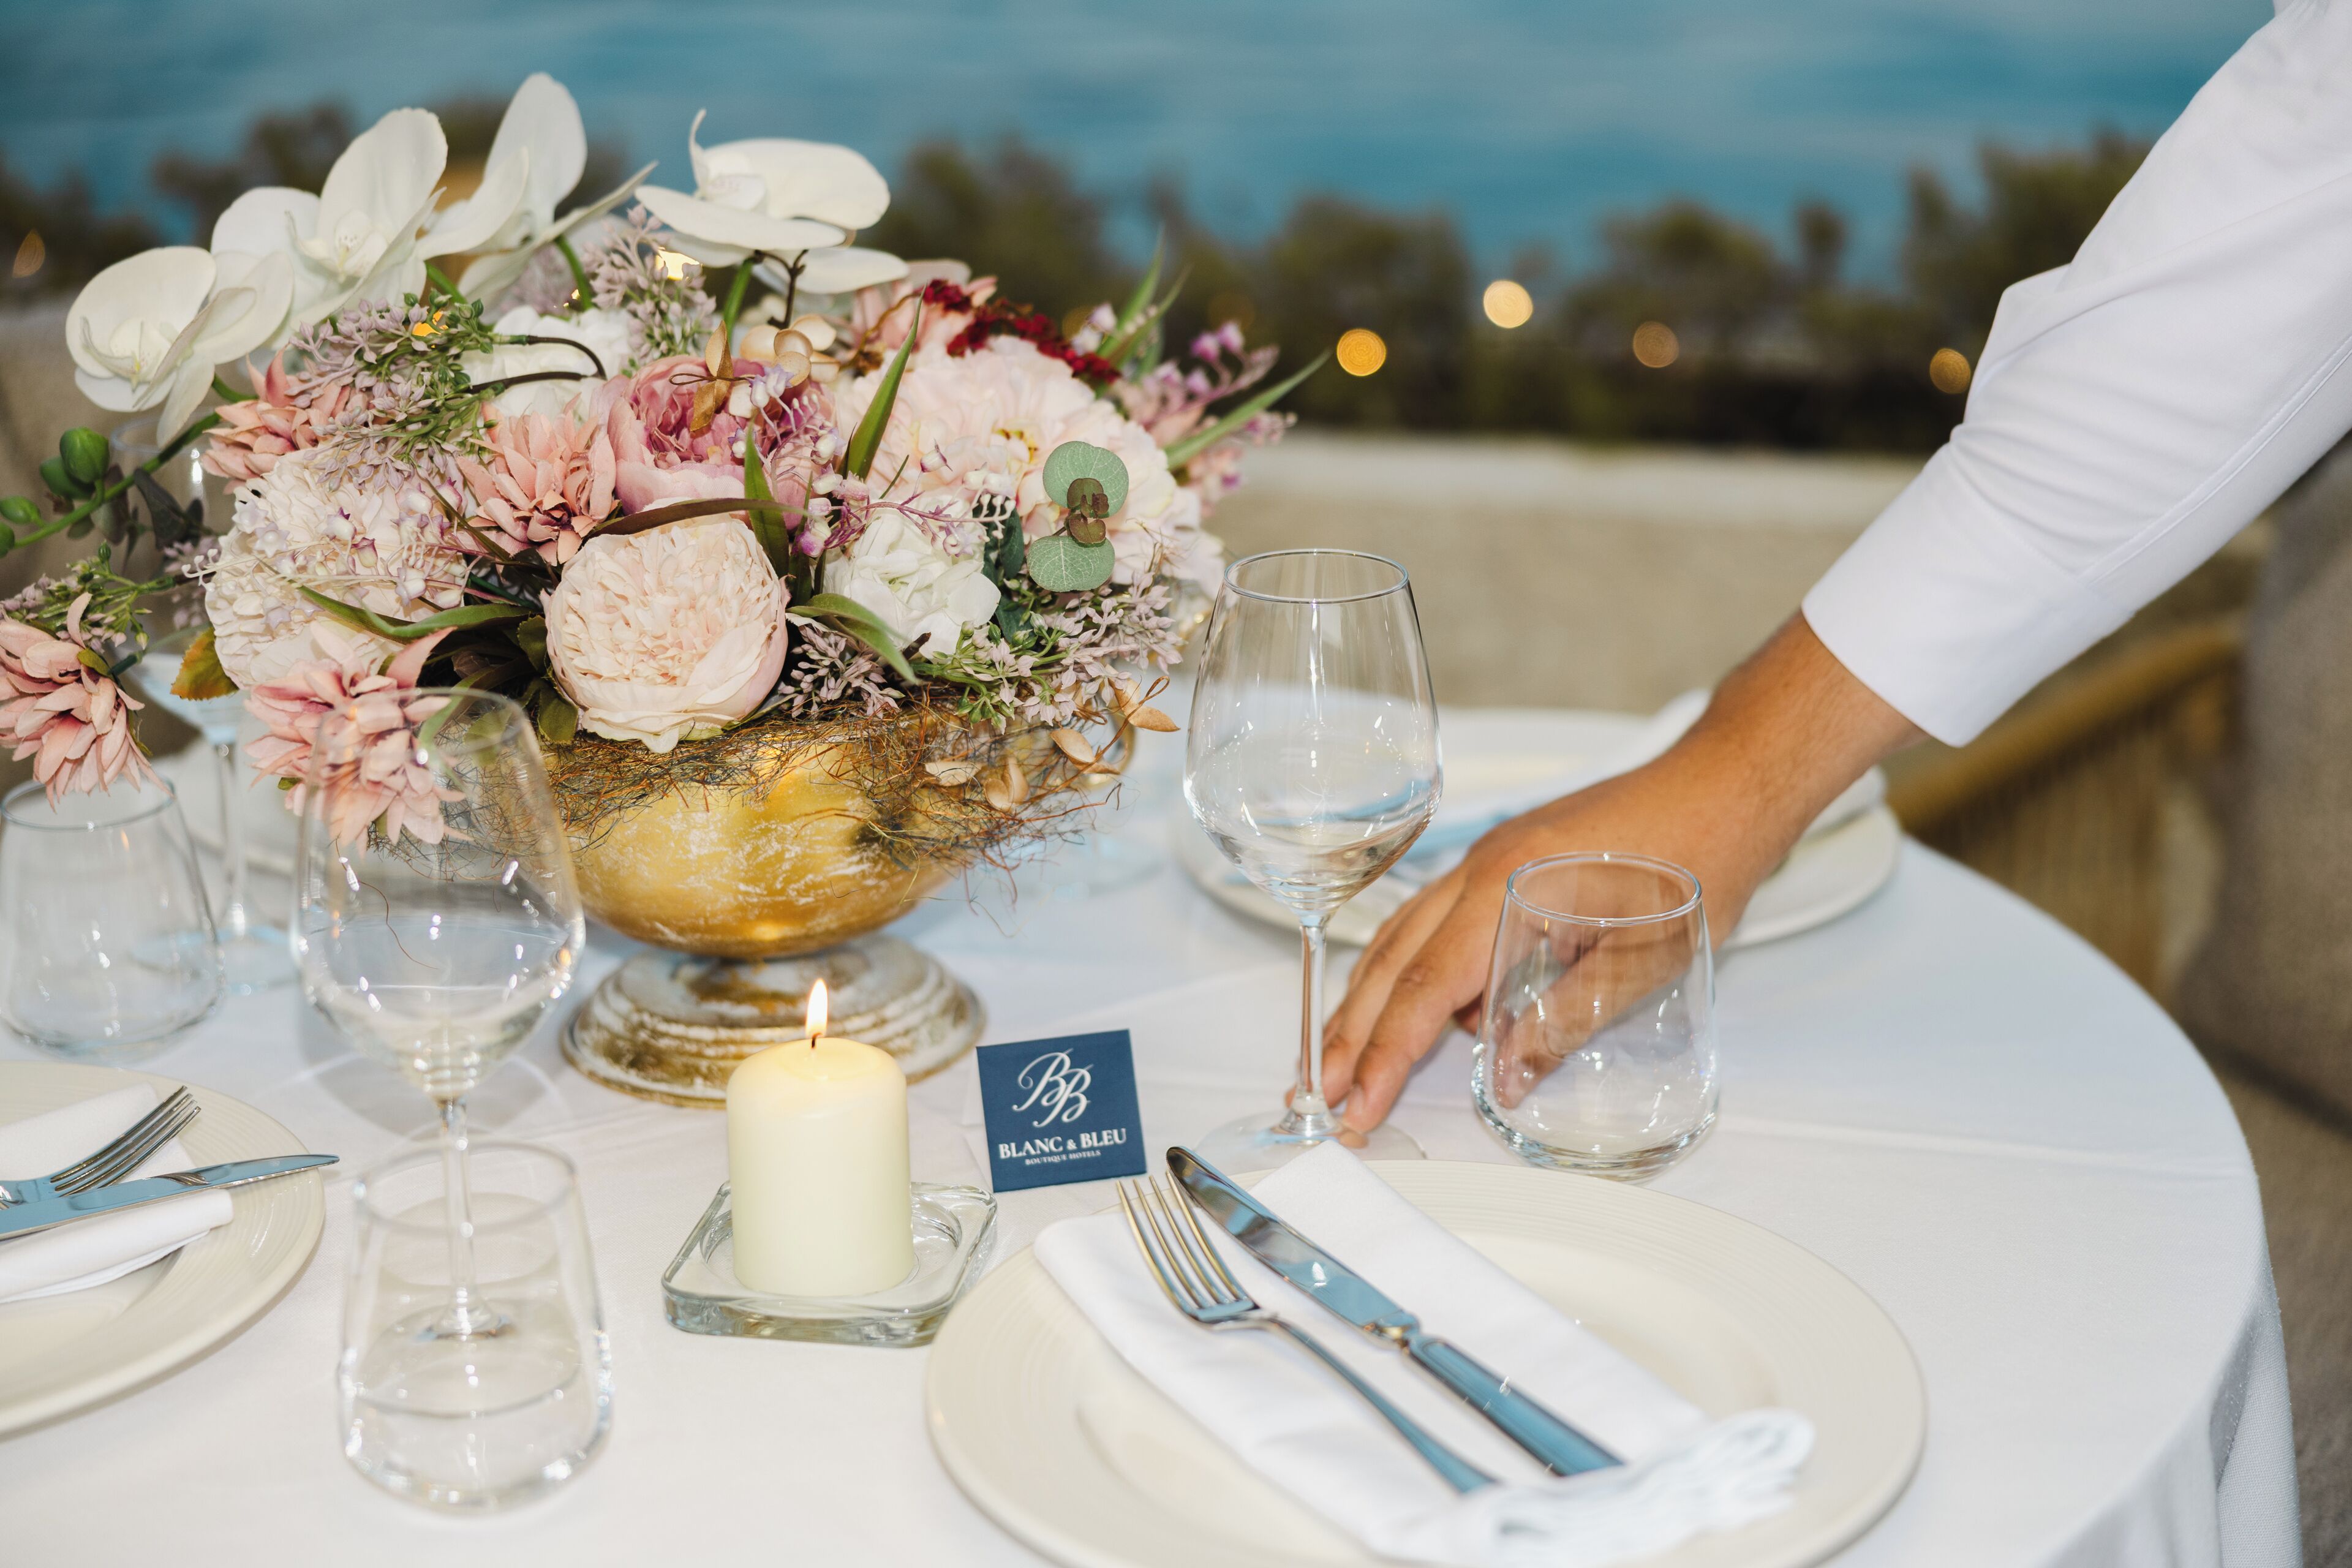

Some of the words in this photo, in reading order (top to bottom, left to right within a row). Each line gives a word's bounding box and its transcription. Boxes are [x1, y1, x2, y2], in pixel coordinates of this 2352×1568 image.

[998, 1136, 1063, 1159] BLANC
[1066, 1139, 1077, 1150] &
[1080, 1128, 1127, 1148] BLEU
[1025, 1153, 1066, 1165] BOUTIQUE
[1068, 1150, 1101, 1160] HOTELS
